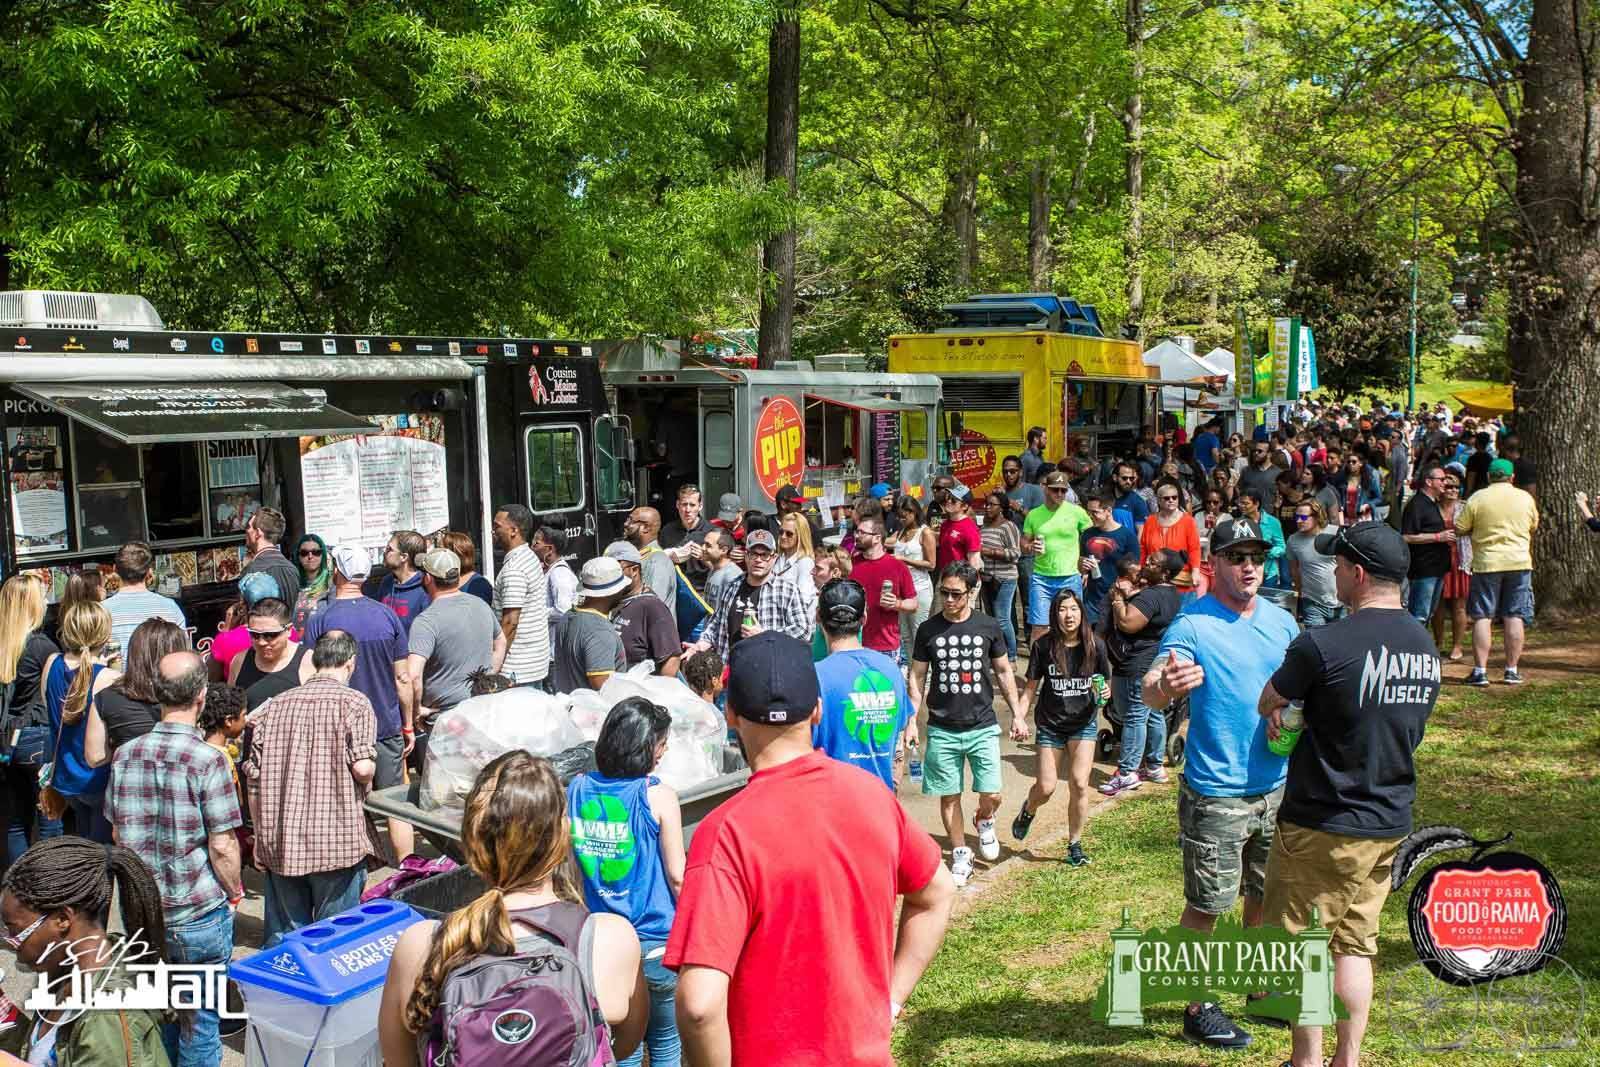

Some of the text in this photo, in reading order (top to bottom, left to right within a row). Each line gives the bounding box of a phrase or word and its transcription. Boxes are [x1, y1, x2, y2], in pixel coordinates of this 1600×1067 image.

[546, 366, 577, 381] Cousins
[554, 379, 577, 391] Maine
[4, 399, 38, 413] PICK
[550, 392, 578, 404] Lobster
[208, 438, 257, 458] SHARK
[761, 426, 801, 476] PUP
[848, 691, 896, 711] WMS
[574, 817, 629, 840] WMS
[340, 934, 398, 964] BOTTLES
[347, 951, 384, 973] CANS
